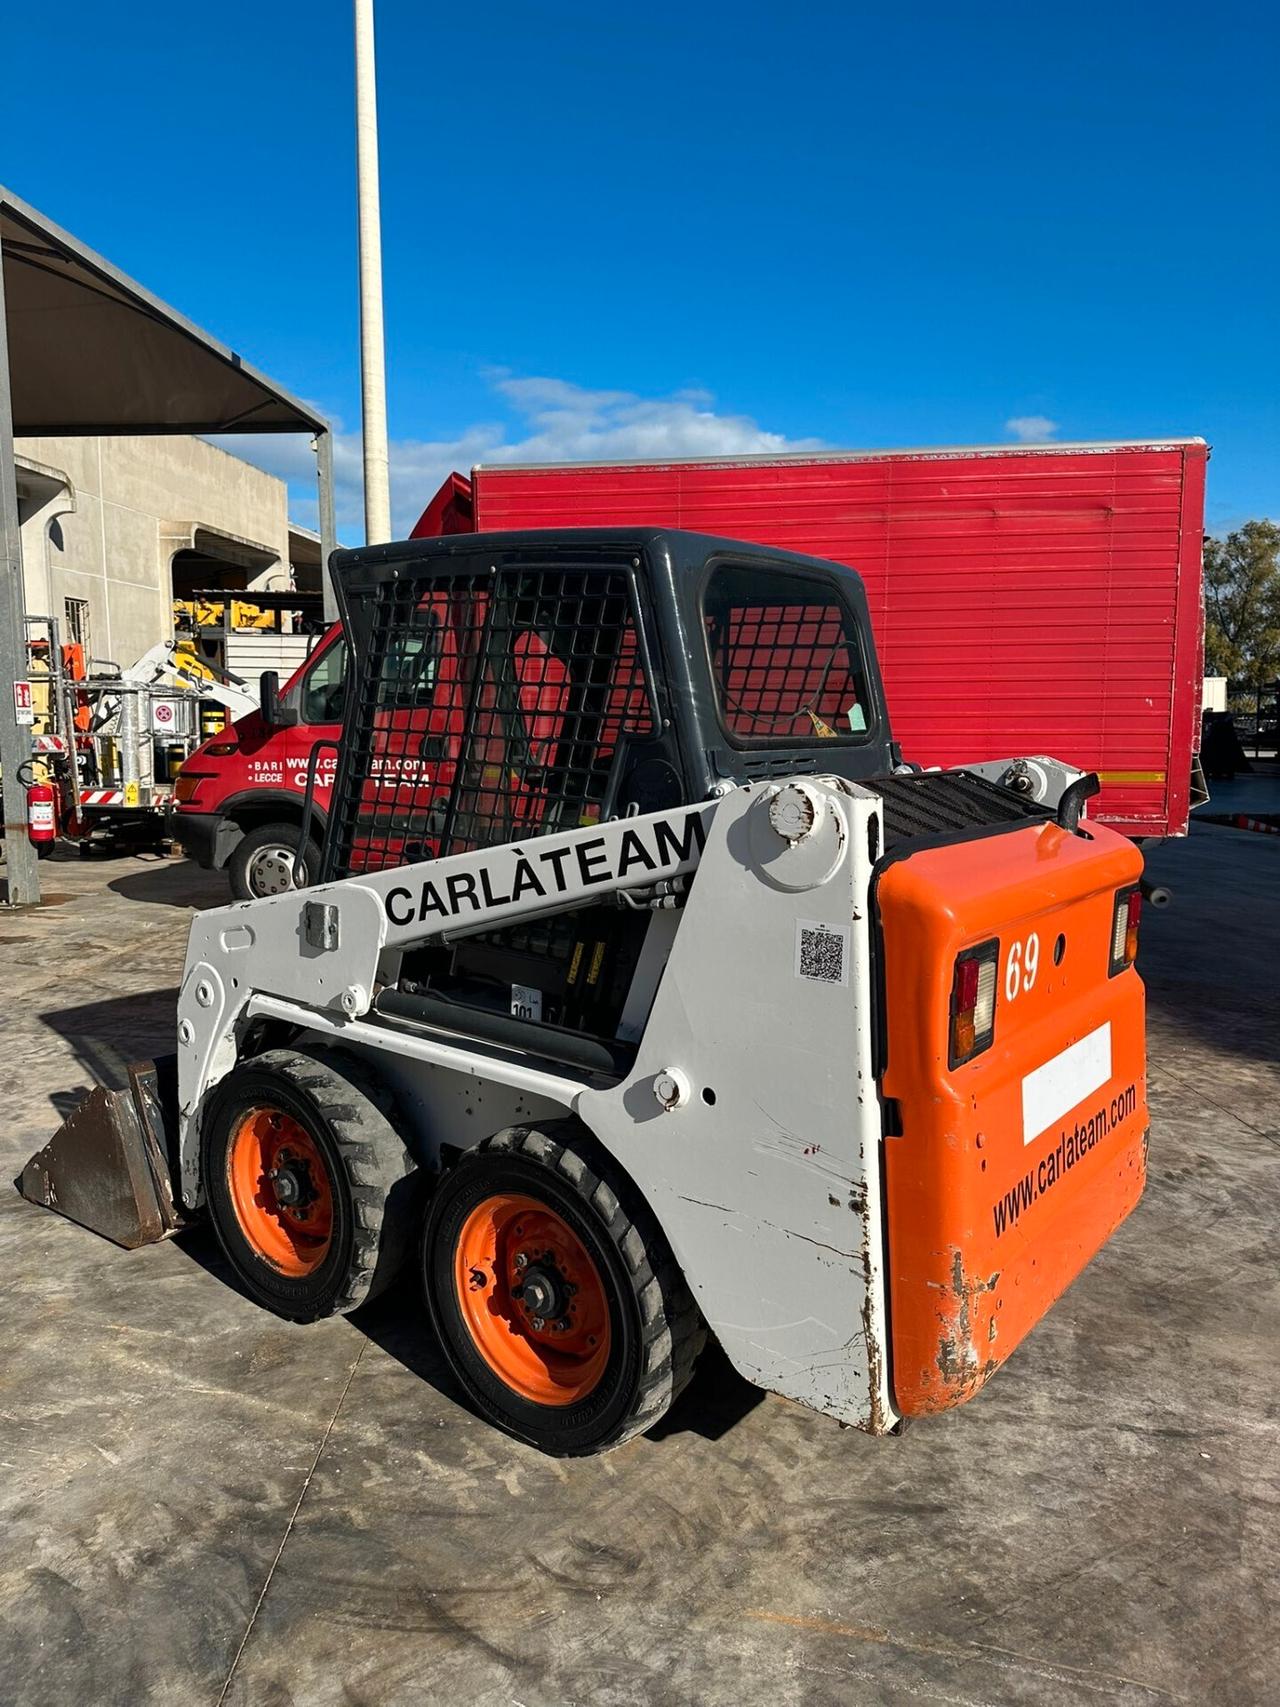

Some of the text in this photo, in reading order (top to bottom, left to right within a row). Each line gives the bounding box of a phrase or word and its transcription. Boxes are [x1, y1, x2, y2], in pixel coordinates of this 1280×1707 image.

[254, 761, 283, 771] BARI
[254, 773, 283, 783] LECCE
[386, 811, 707, 926] CARLÀTEAM
[1005, 931, 1040, 1003] 69
[513, 1003, 532, 1019] 101
[993, 1083, 1136, 1239] www.carlateam.com
